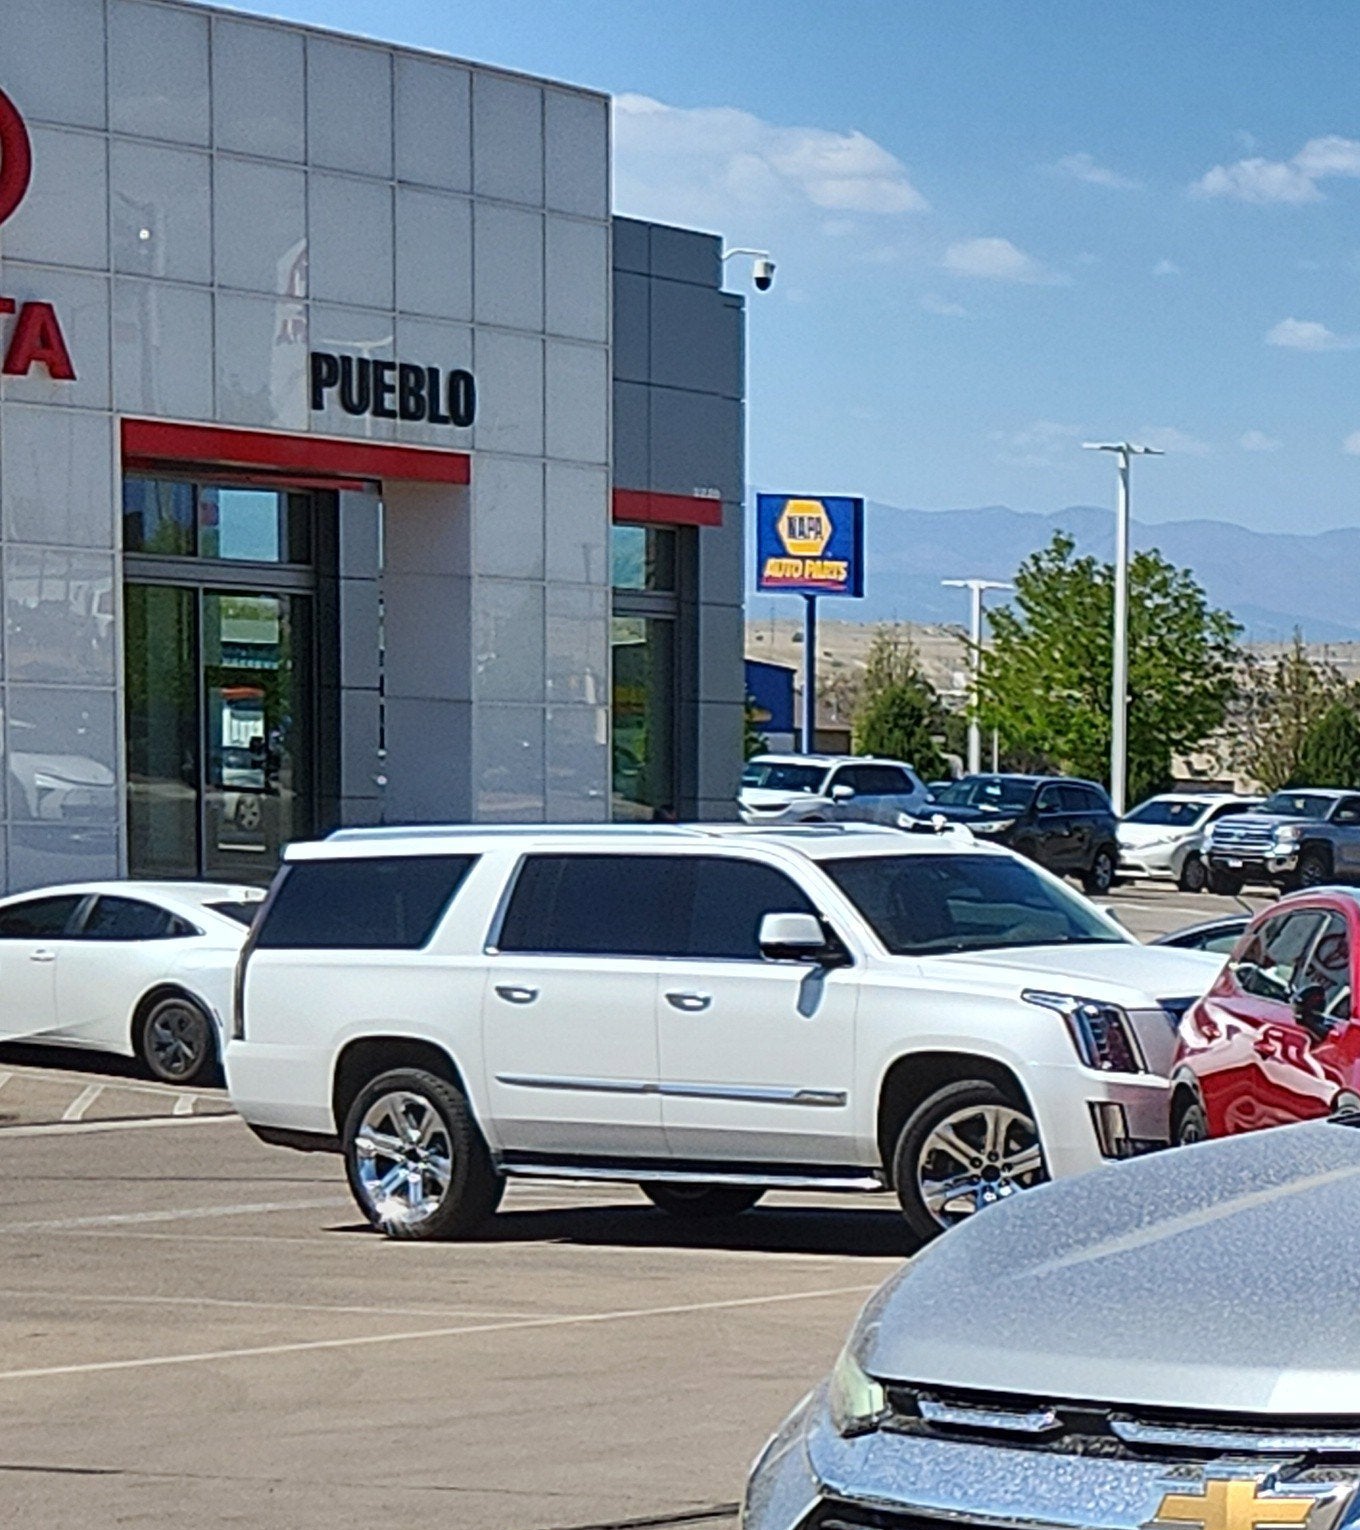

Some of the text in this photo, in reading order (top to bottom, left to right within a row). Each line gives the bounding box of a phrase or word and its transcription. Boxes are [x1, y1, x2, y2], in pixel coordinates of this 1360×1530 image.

[0, 297, 77, 381] A
[310, 351, 476, 428] PUEBLO
[786, 515, 825, 542] NAPA
[763, 558, 849, 582] AUTO PARTS
